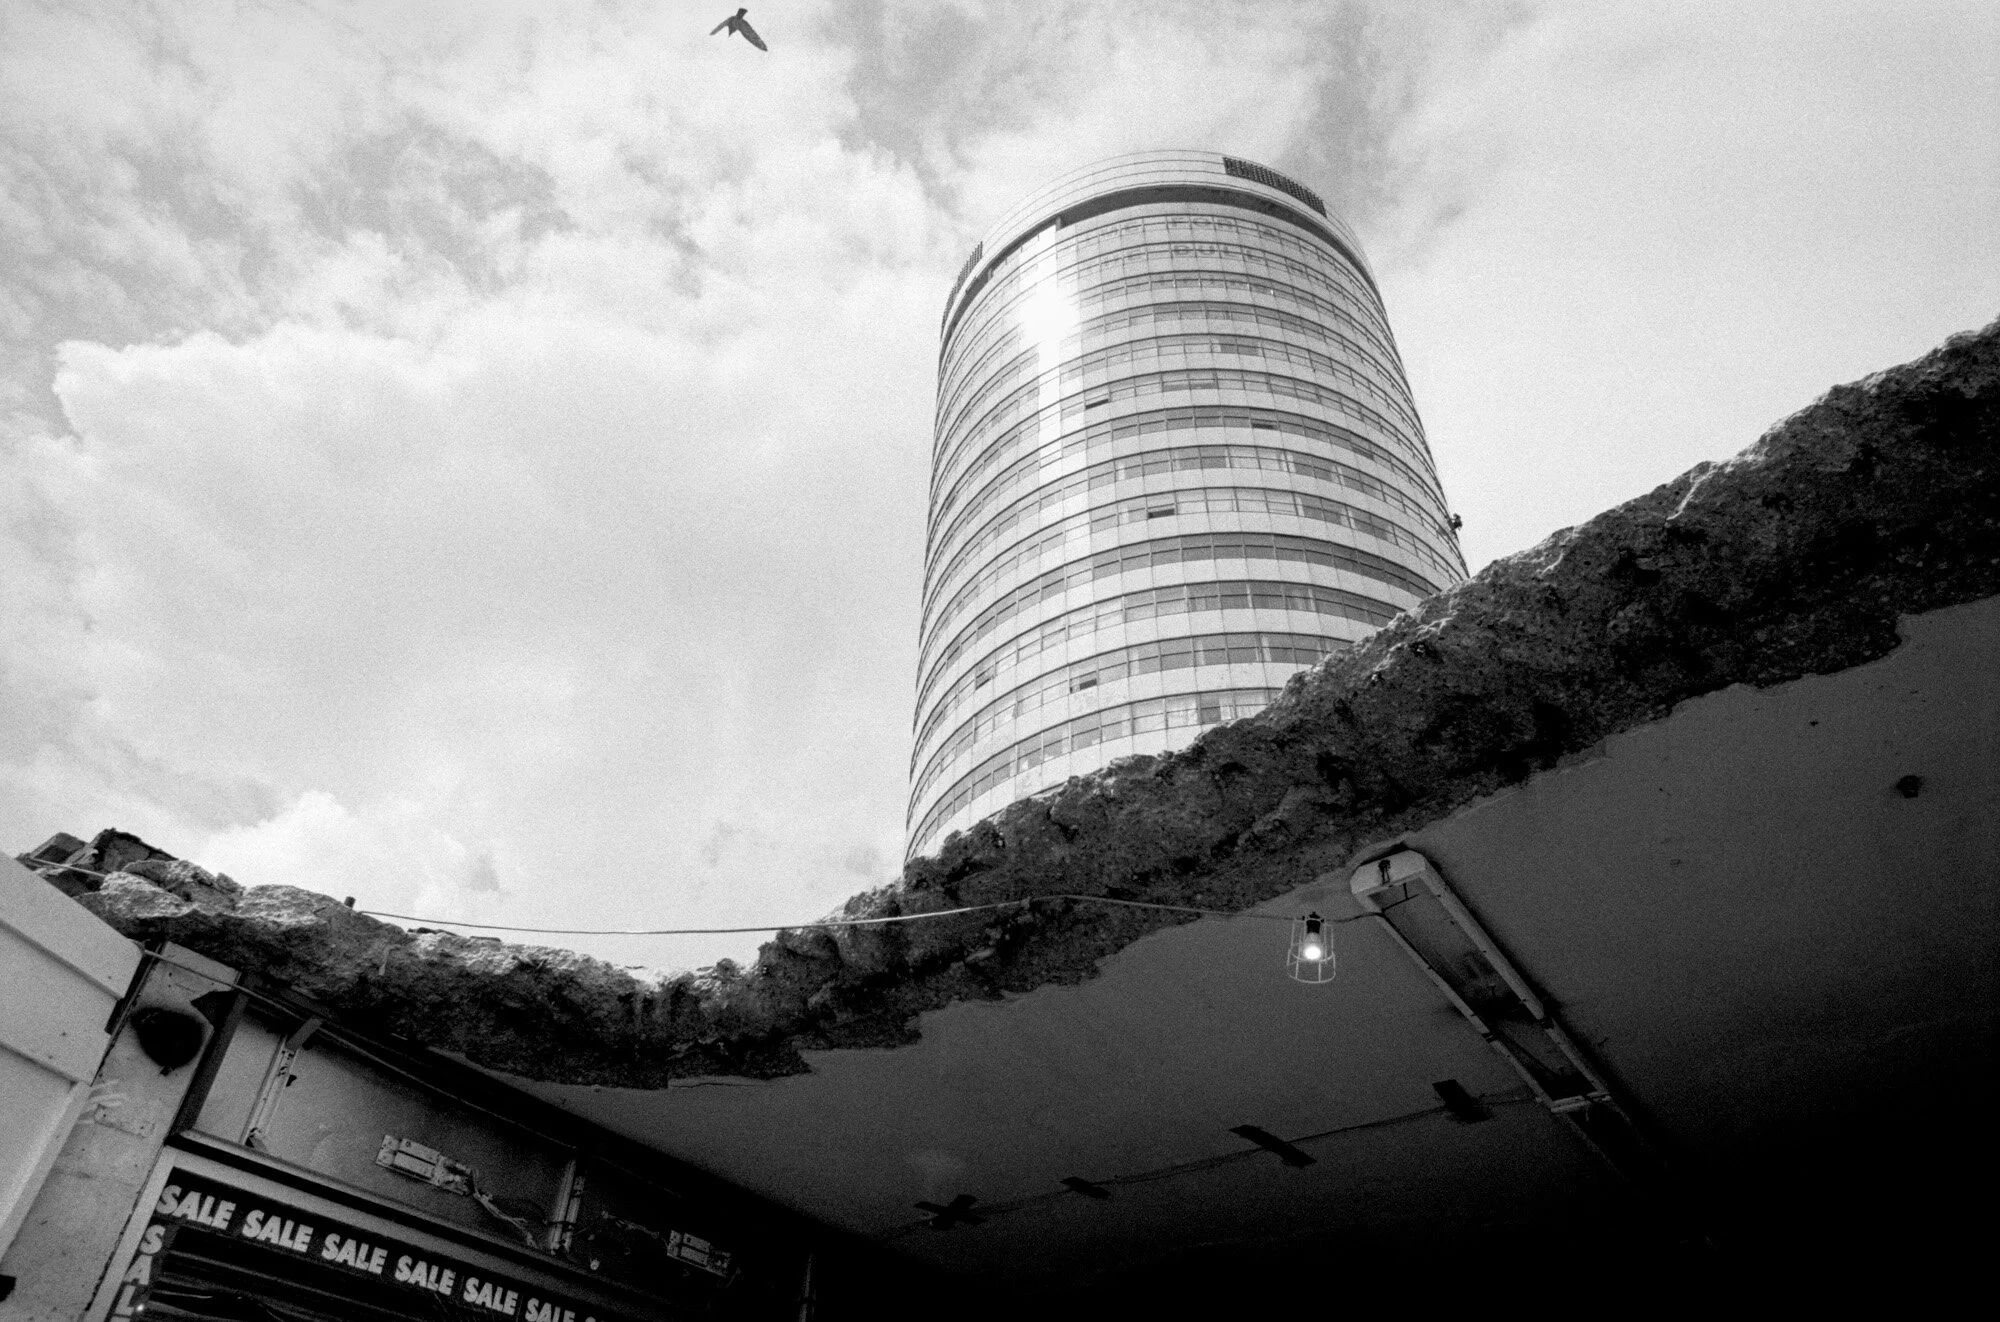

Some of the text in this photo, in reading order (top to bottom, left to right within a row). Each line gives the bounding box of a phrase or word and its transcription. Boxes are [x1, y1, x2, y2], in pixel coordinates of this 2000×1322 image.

[111, 1224, 166, 1322] SAL
[155, 1184, 237, 1230] SALE
[242, 1209, 314, 1253] SALE
[321, 1232, 389, 1275] SALE
[394, 1254, 456, 1296] SALE
[463, 1276, 519, 1316] SALE
